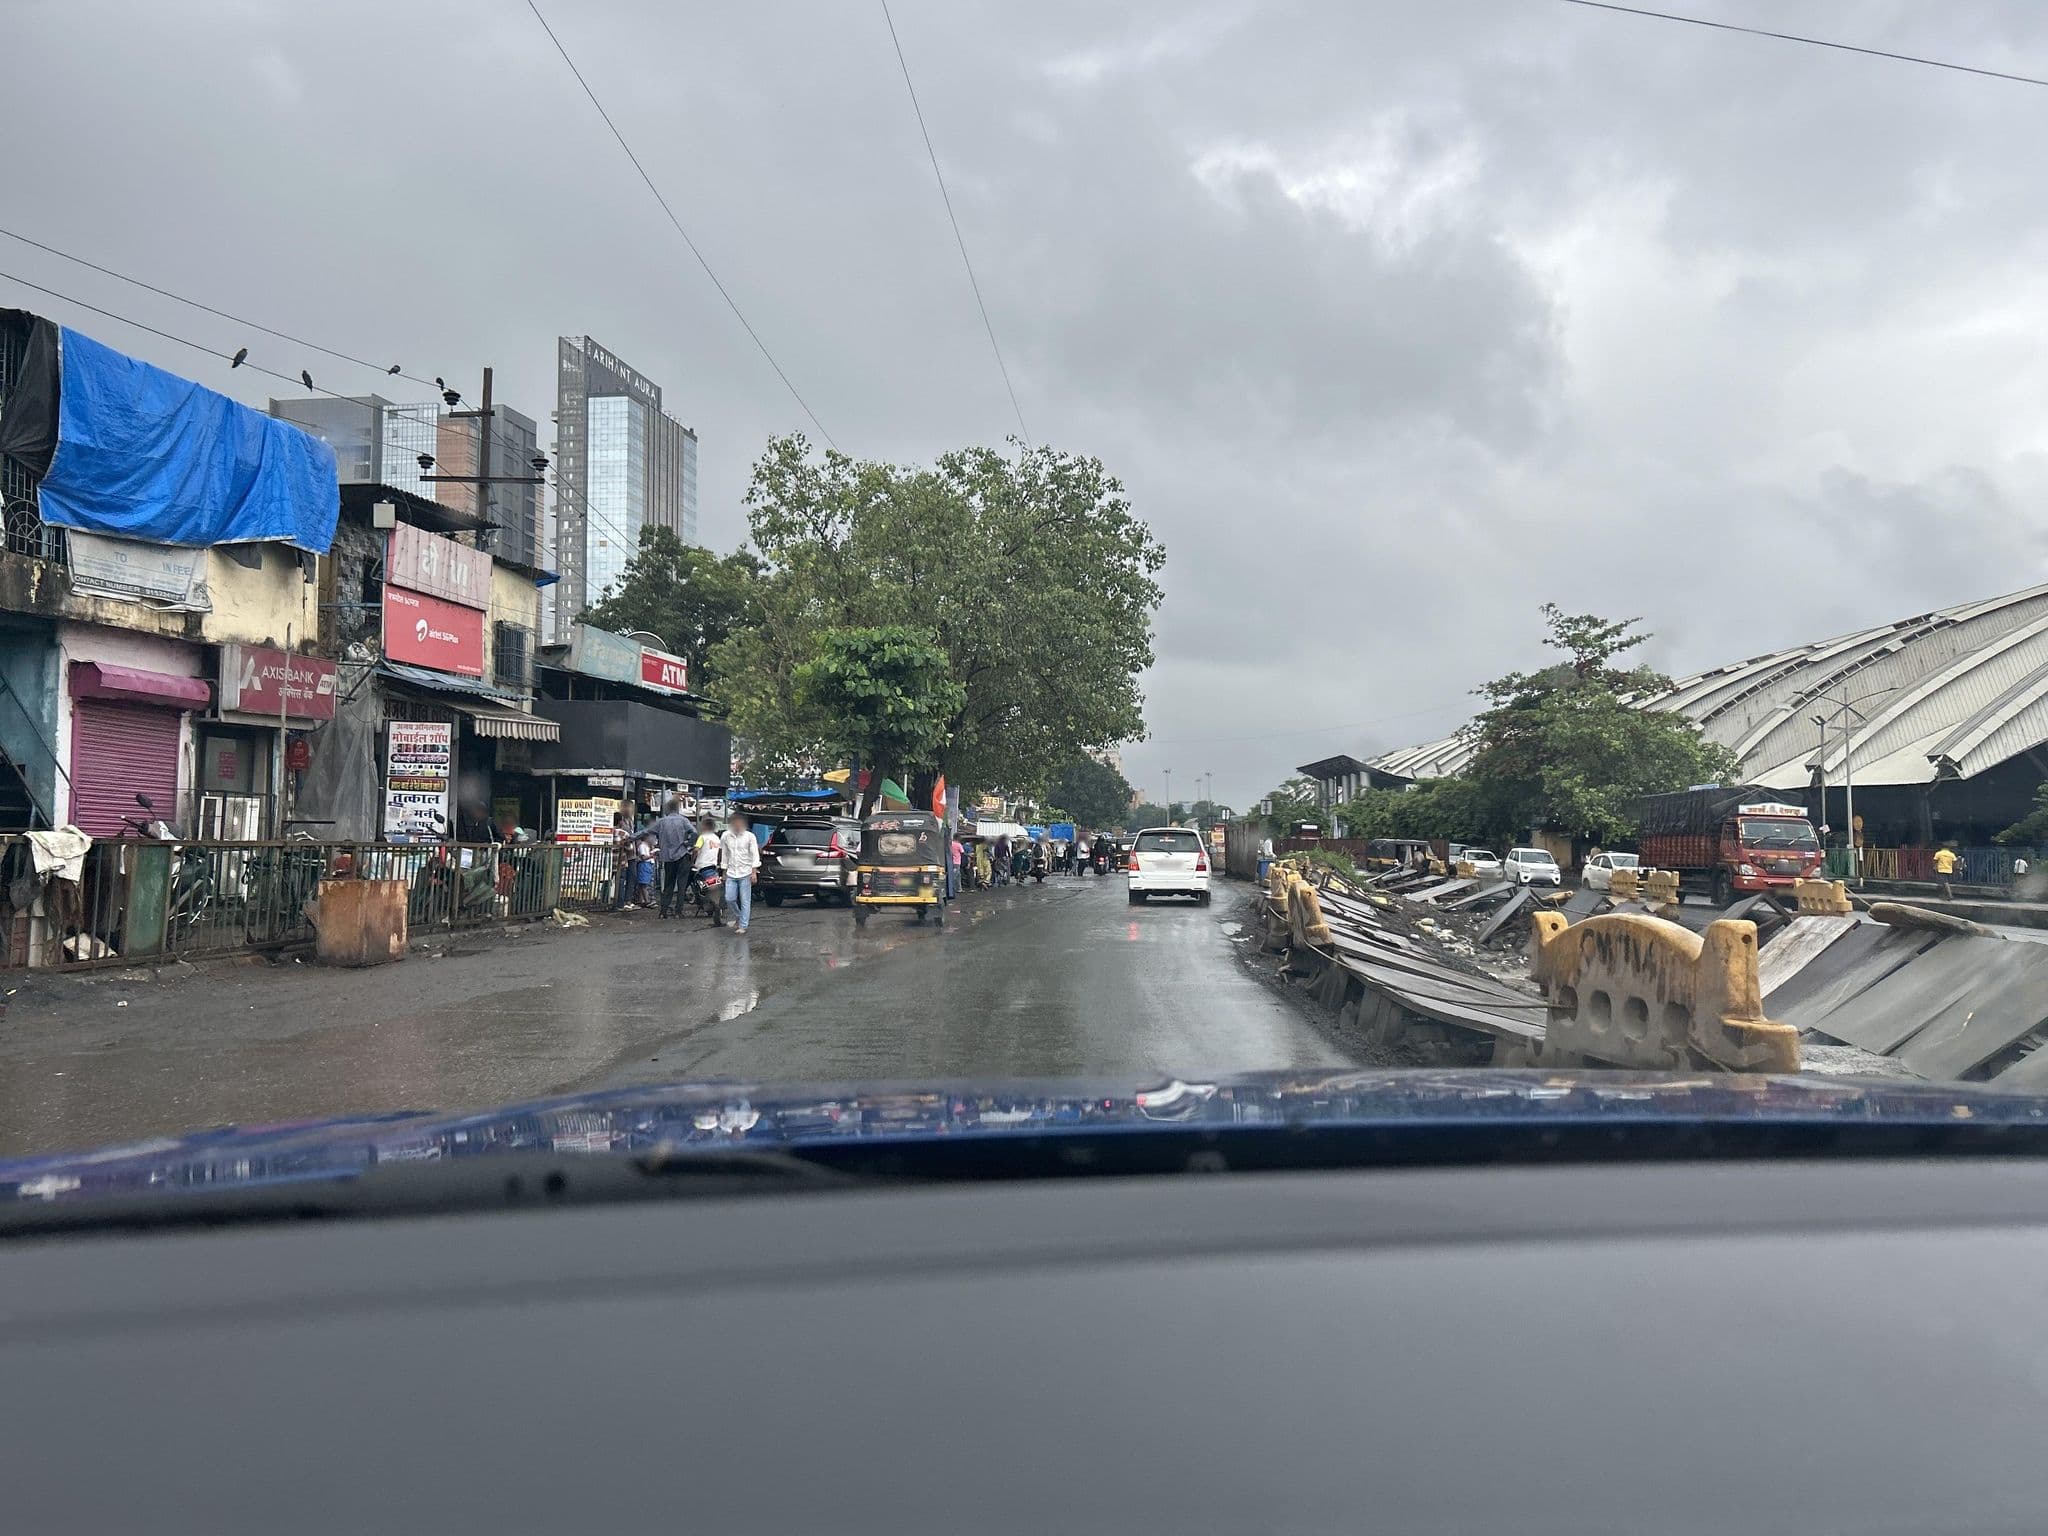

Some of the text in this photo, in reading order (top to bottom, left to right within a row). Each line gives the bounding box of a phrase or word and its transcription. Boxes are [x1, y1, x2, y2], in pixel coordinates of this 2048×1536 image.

[593, 348, 656, 400] ARIHANT AURA
[261, 665, 314, 684] AXIS BANK
[320, 680, 331, 689] ATM
[661, 663, 686, 688] ATM
